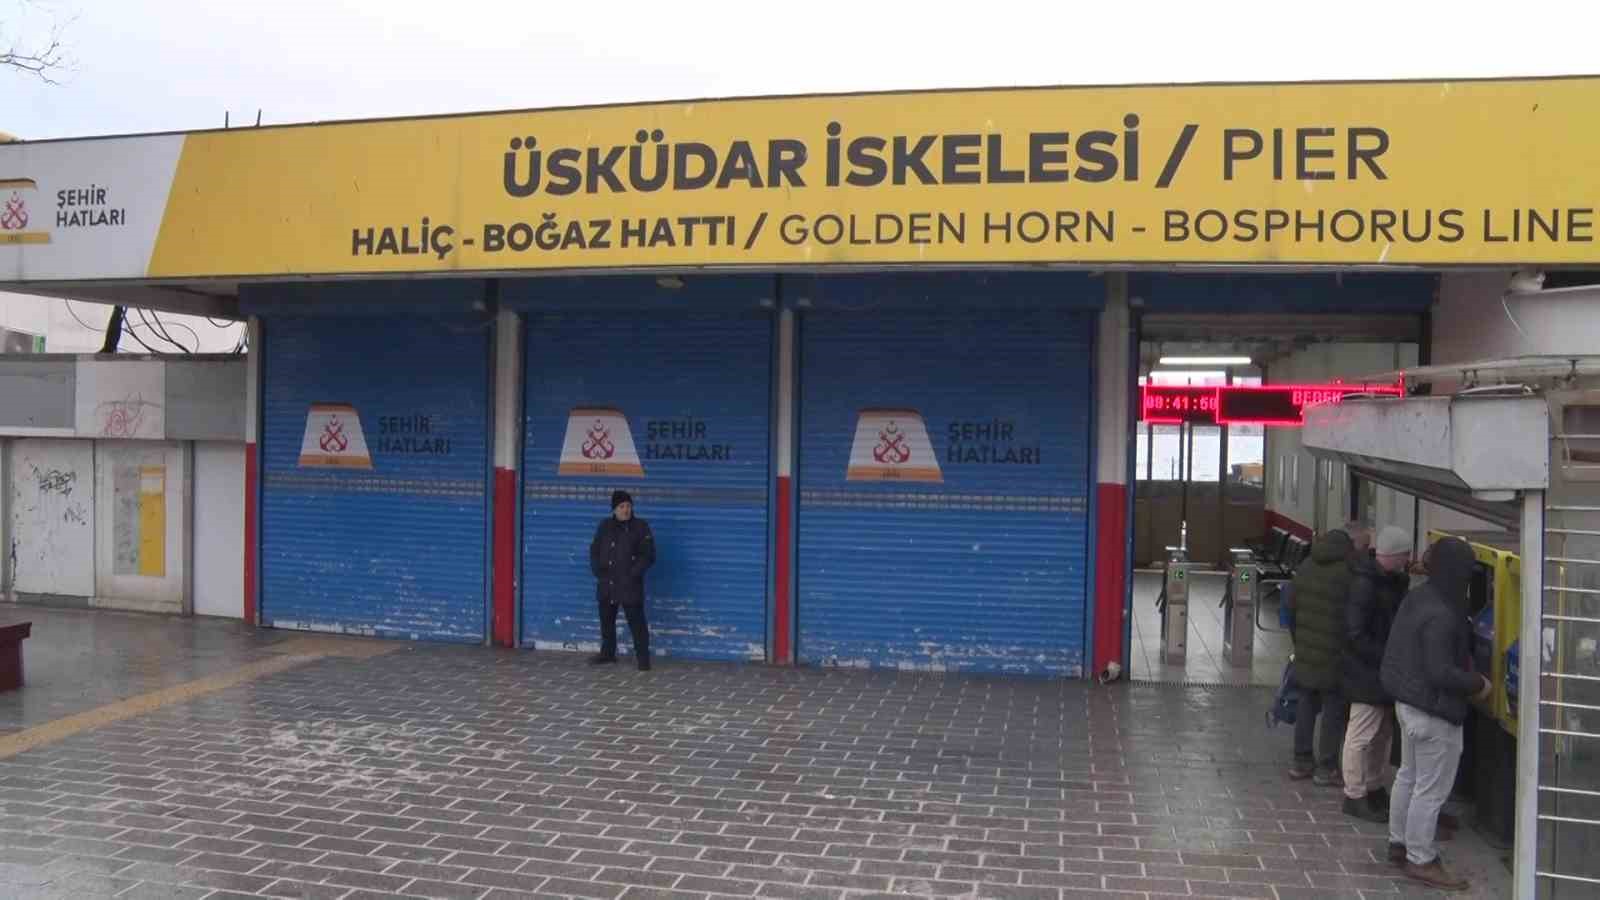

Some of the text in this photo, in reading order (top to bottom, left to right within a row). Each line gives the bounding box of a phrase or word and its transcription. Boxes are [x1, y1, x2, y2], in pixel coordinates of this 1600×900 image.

[504, 113, 1390, 198] ÜSKÜDAR İSKELESİ / PIER
[57, 184, 107, 209] ŞEHİR
[56, 208, 125, 228] HATLARI
[351, 216, 454, 260] HALİÇ
[482, 213, 612, 252] BOĞAZ
[621, 215, 736, 249] HATTI
[779, 211, 966, 246] GOLDEN
[983, 210, 1115, 244] HORN
[1163, 208, 1465, 243] BOSPHORUS
[1483, 208, 1594, 243] LINE
[378, 413, 432, 435] ŞEHİR
[646, 417, 707, 441] ŞEHİR
[947, 417, 1015, 444] ŞEHİR
[377, 436, 451, 455] HATLARI
[644, 443, 731, 461] HATLARI
[947, 446, 1042, 465] HATLARI
